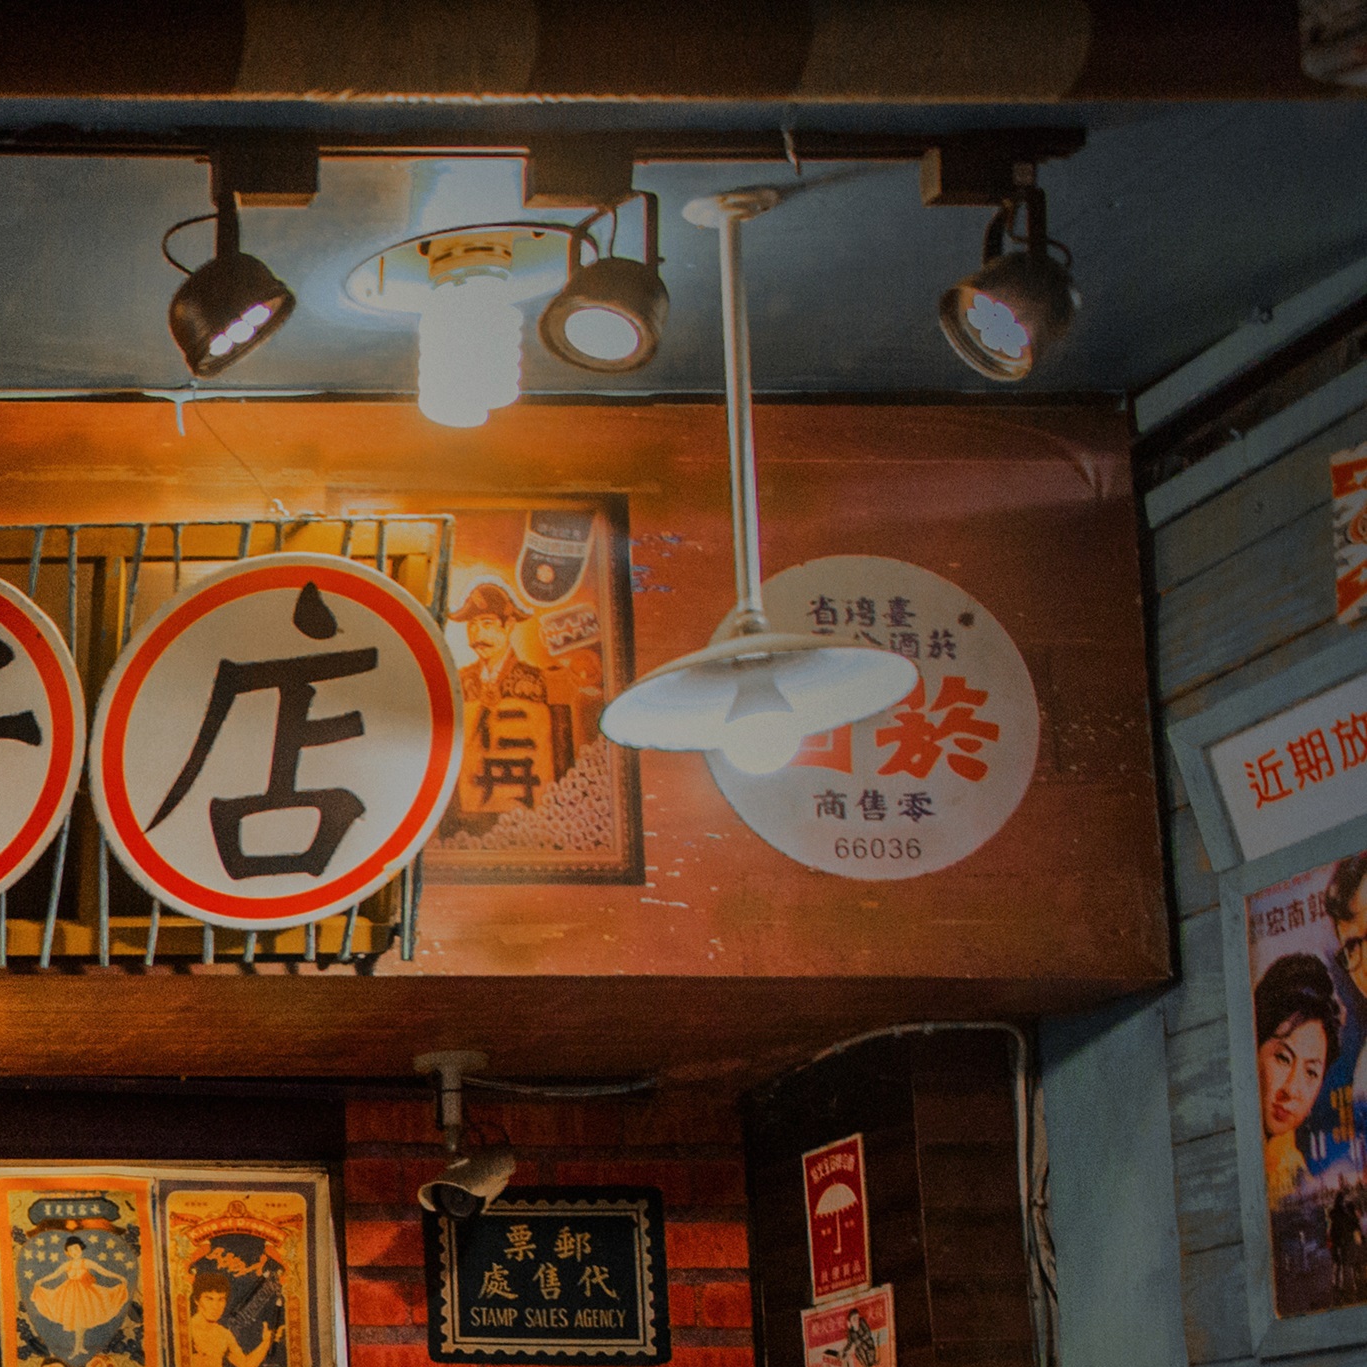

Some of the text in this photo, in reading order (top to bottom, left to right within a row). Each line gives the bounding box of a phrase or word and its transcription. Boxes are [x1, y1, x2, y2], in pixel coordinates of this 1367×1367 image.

[834, 838, 923, 861] 66036
[470, 1307, 629, 1329] STAMP SALES AGENCY
